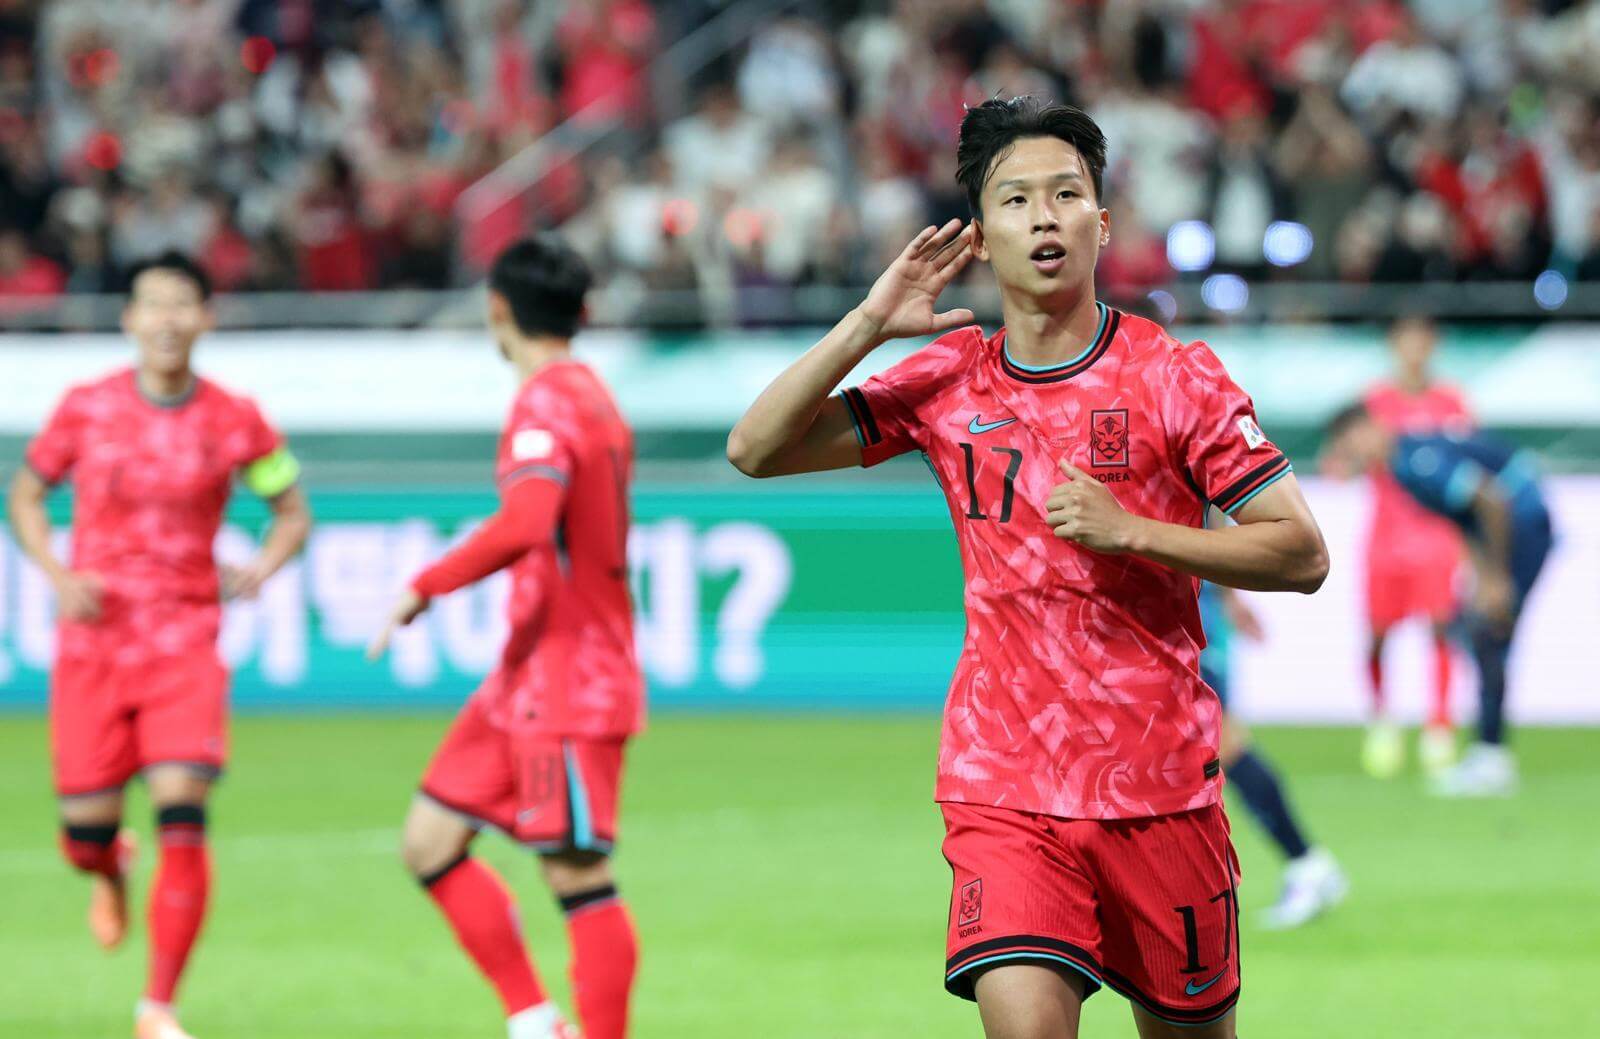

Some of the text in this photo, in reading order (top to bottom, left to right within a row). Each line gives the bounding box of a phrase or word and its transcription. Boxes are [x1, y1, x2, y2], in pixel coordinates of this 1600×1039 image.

[958, 442, 1022, 523] 17
[959, 925, 982, 939] KOREA
[1174, 889, 1231, 974] 17
